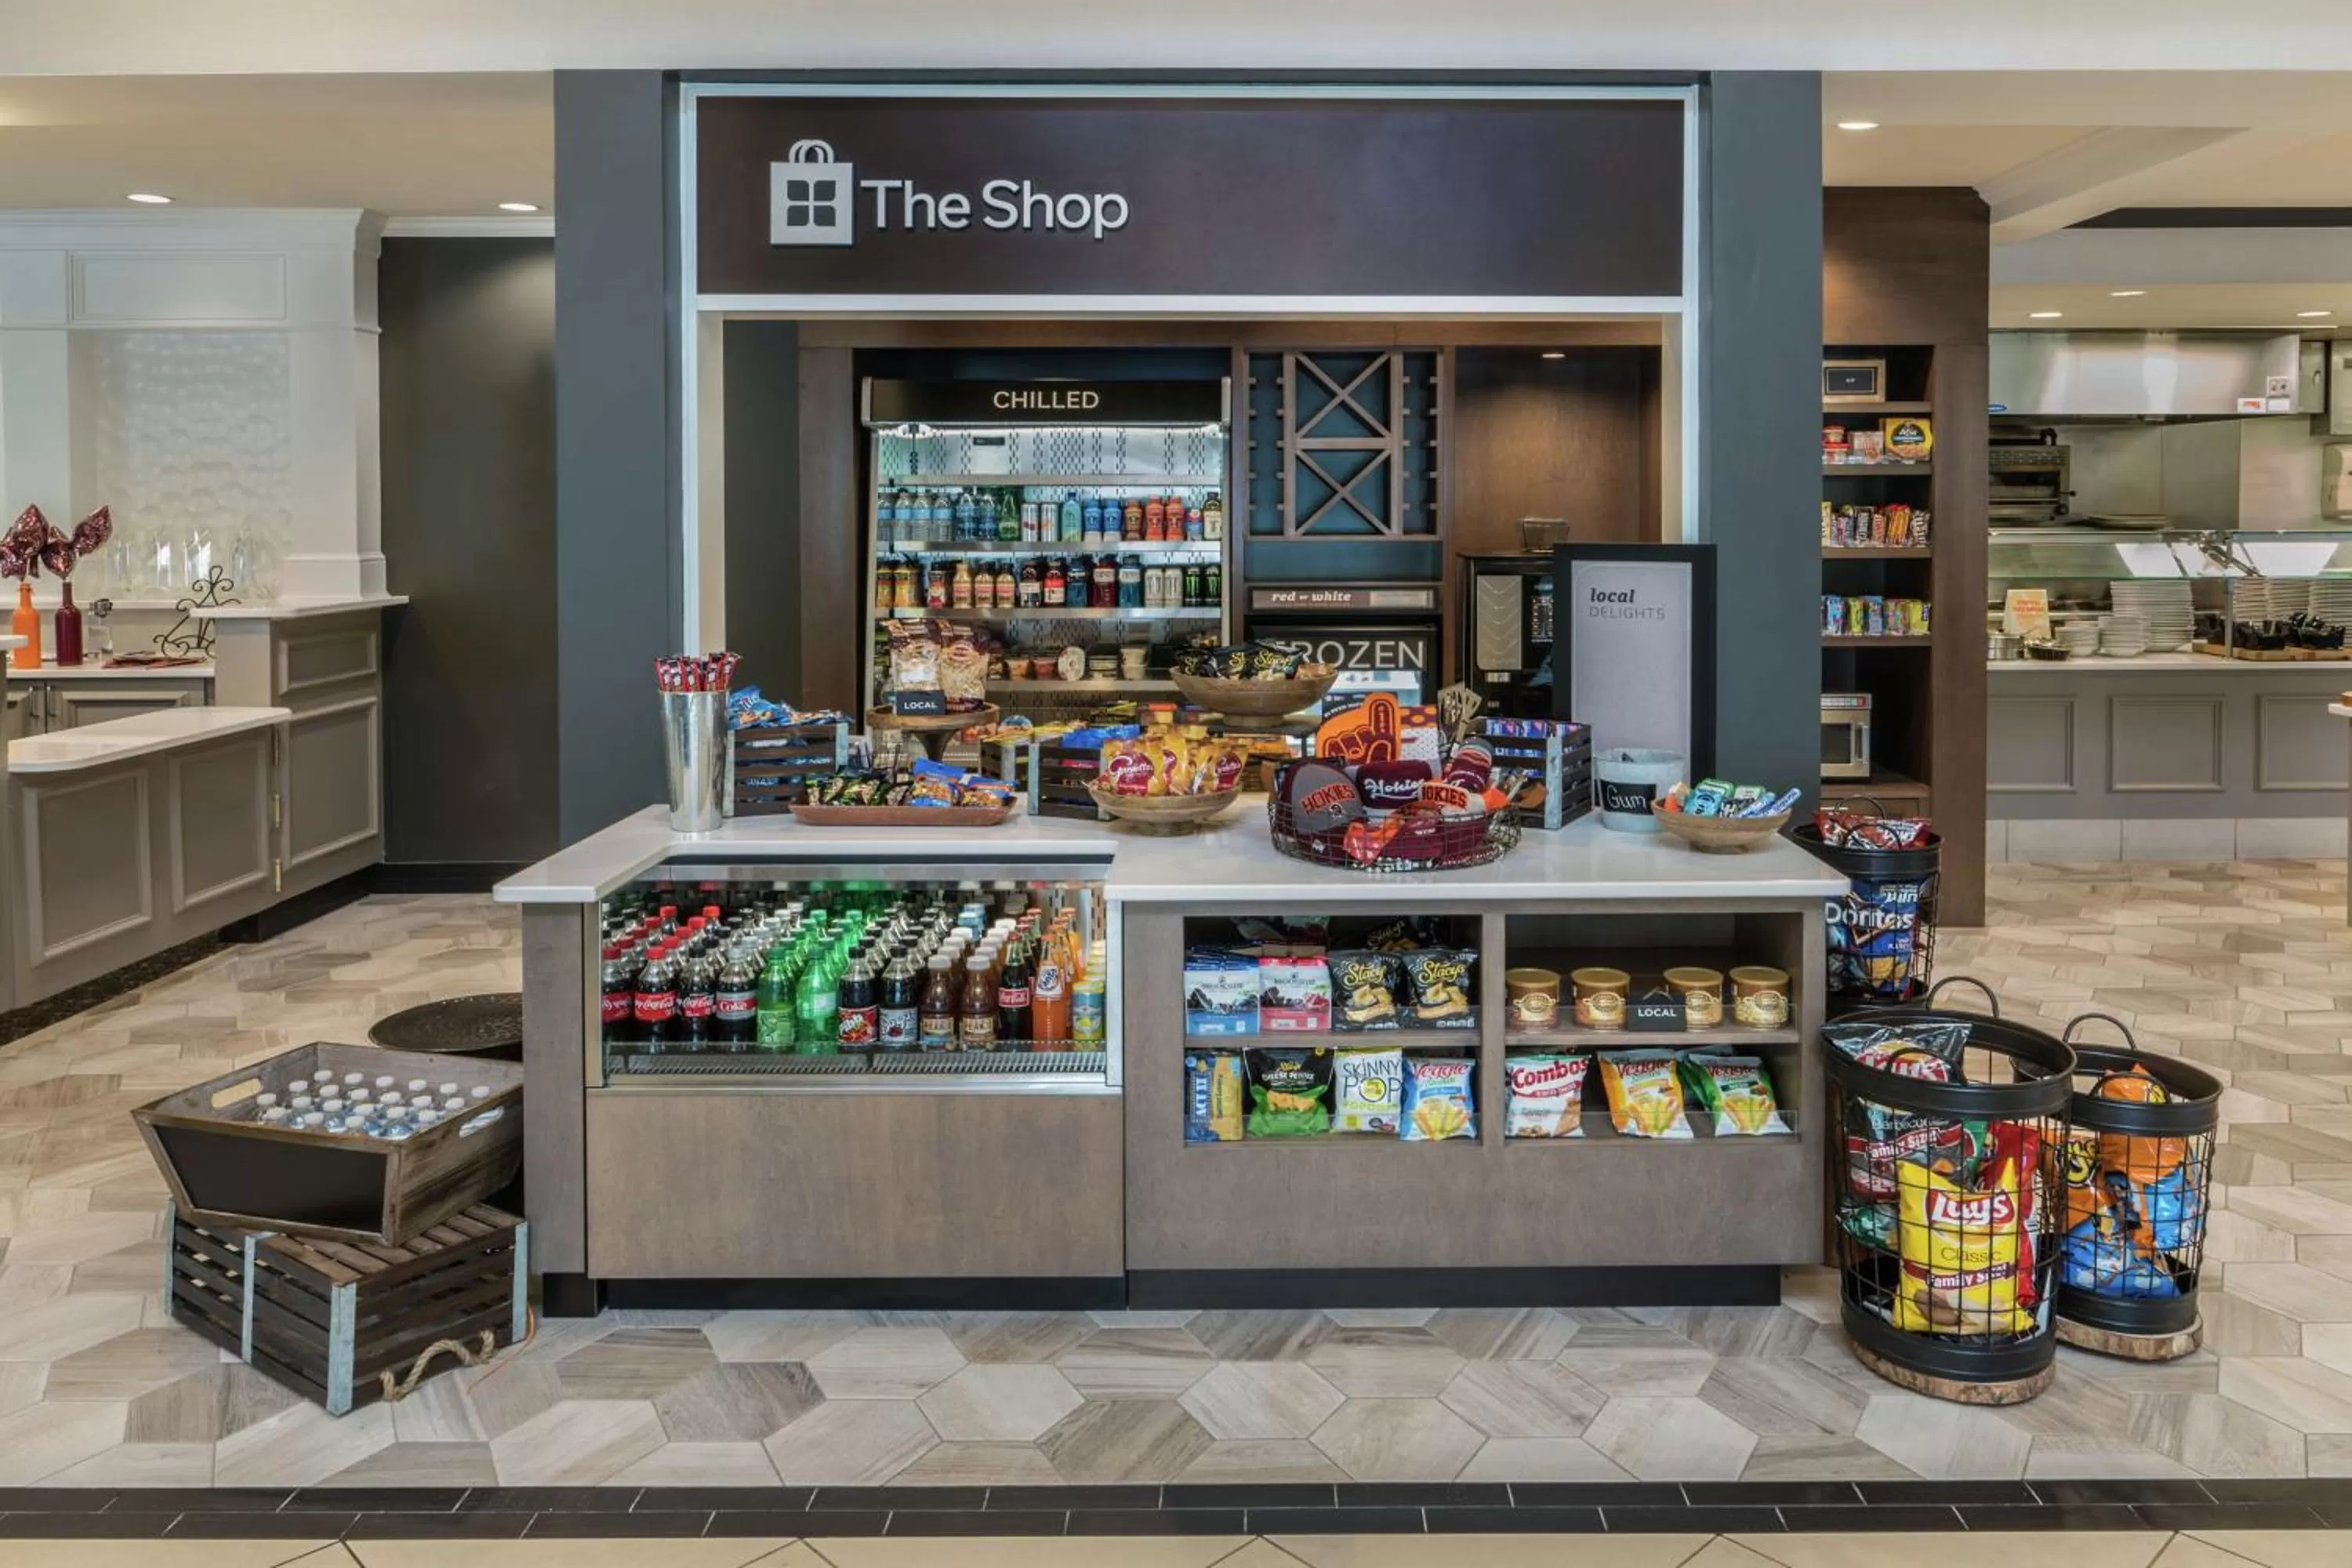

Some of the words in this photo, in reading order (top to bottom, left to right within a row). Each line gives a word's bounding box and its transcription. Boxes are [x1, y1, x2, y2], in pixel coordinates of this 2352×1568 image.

[861, 180, 971, 228] The
[982, 180, 1128, 238] Shop
[993, 390, 1099, 409] CHILLED
[1272, 592, 1296, 602] red
[1312, 592, 1352, 602] white
[1590, 588, 1635, 603] local
[1589, 606, 1666, 619] DELIGHTS
[1301, 784, 1356, 815] HOKIES
[1607, 785, 1646, 809] Gum
[1825, 902, 1914, 928] Doritos
[1638, 1007, 1676, 1017] LOCAL
[1343, 1058, 1401, 1076] SKINNY
[1513, 1059, 1589, 1088] Combos
[1344, 1075, 1403, 1104] POP
[1871, 1141, 1906, 1159] amily
